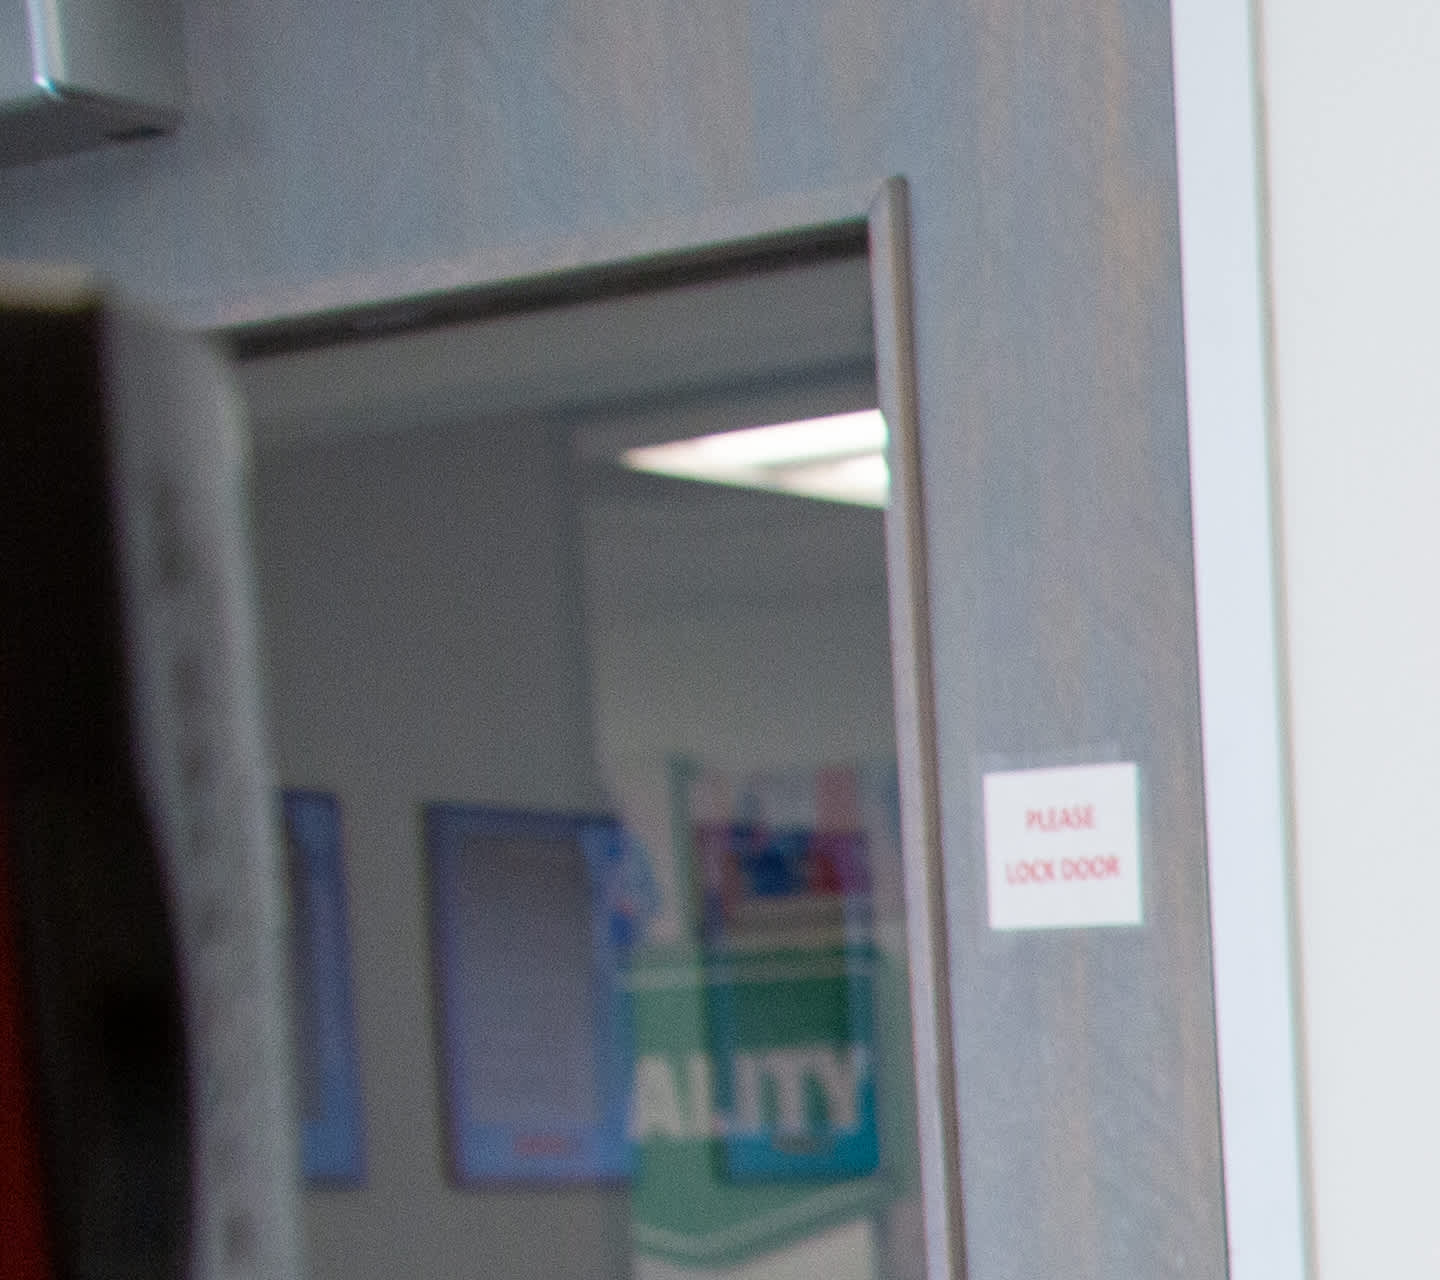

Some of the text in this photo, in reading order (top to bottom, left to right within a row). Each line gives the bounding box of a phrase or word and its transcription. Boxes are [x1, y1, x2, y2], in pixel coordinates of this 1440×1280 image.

[1025, 803, 1095, 832] PLEASE
[1005, 852, 1120, 886] LOCK DOOR
[630, 1044, 872, 1140] ALITY
